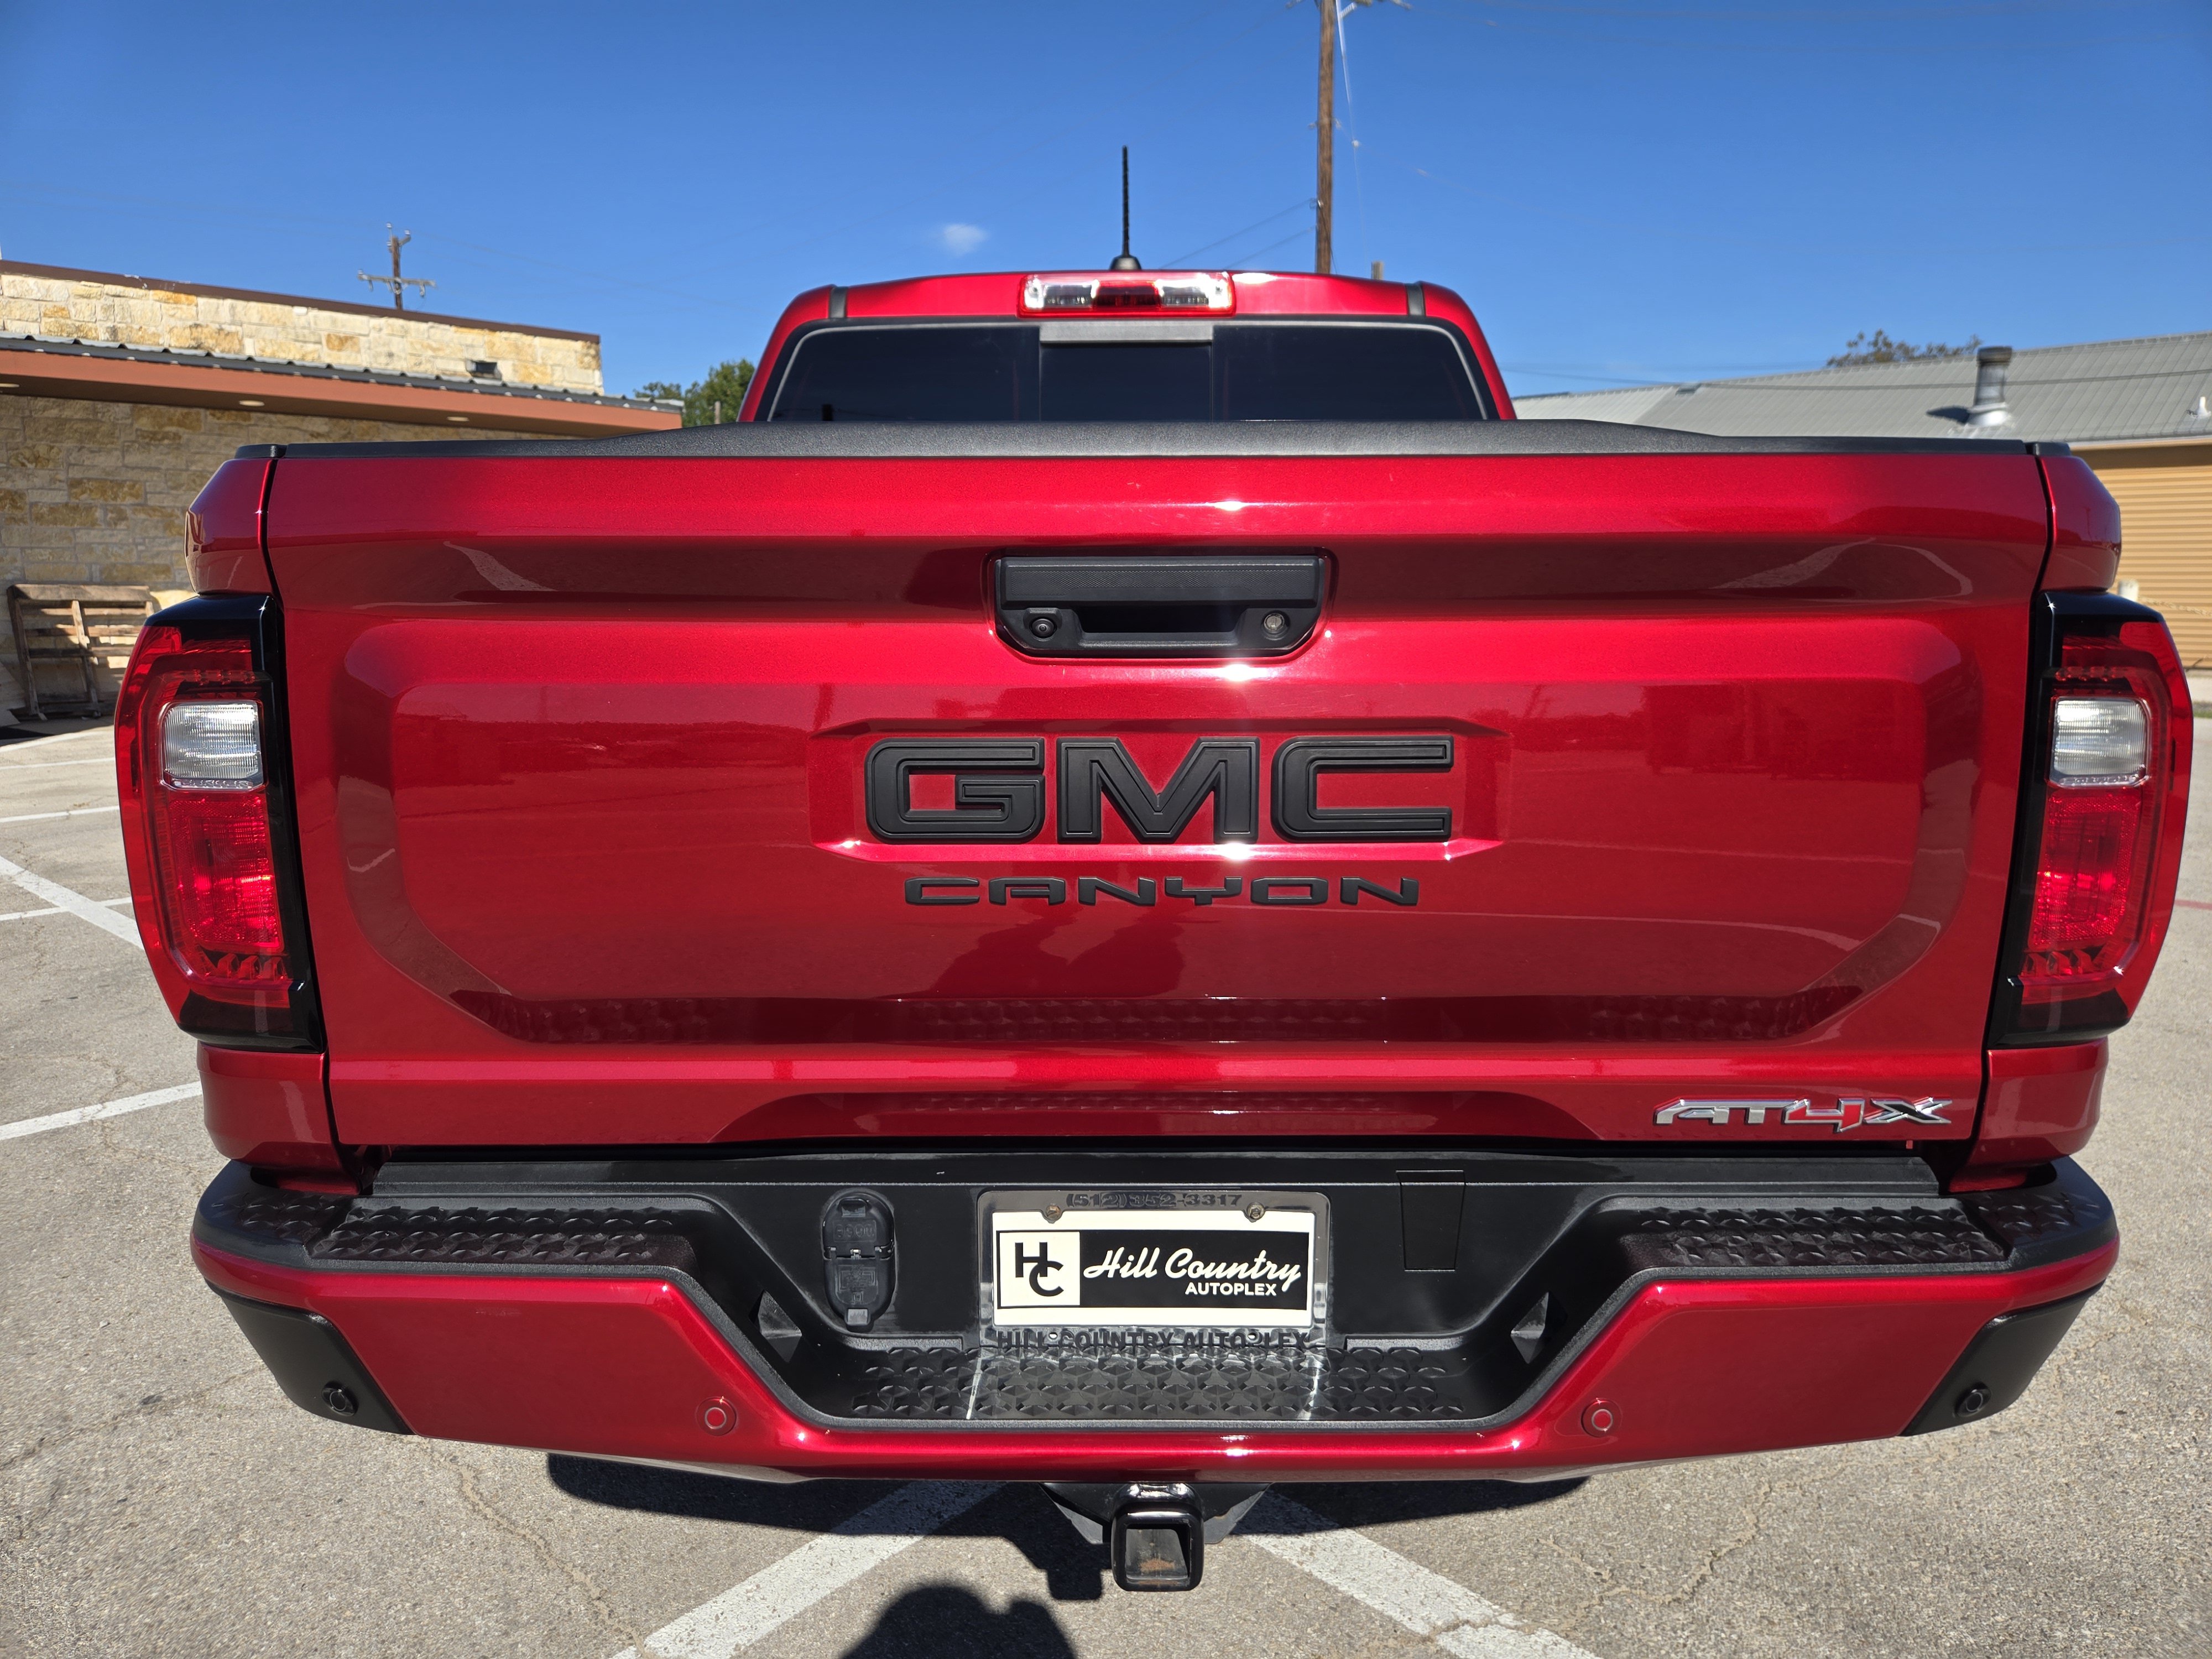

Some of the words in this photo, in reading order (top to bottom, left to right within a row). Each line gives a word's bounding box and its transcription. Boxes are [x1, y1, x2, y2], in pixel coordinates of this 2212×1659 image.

[864, 736, 1454, 844] GMC
[904, 877, 1419, 906] CANYON
[1654, 1098, 1953, 1133] AT4X
[1083, 1246, 1160, 1279] Hill
[1165, 1248, 1301, 1292] Country
[1185, 1282, 1277, 1296] AUTOPLEX
